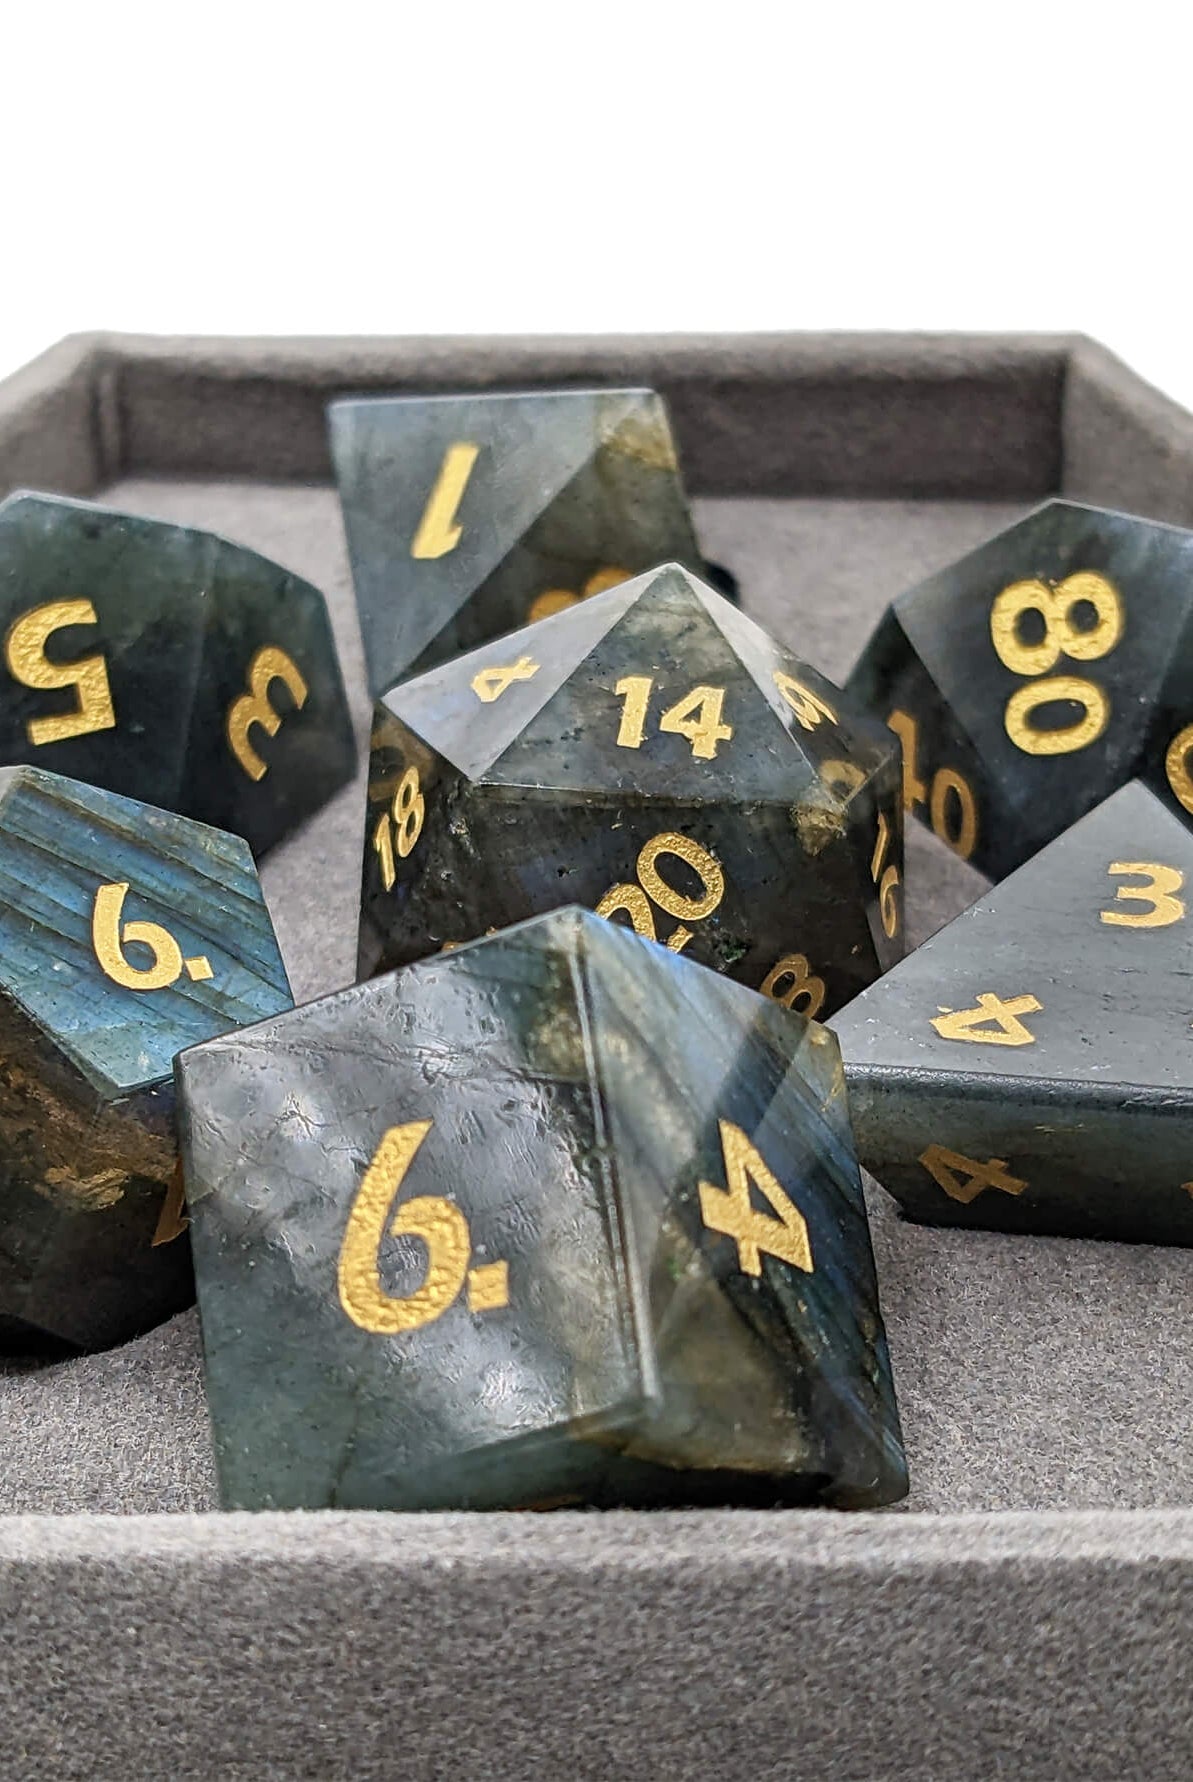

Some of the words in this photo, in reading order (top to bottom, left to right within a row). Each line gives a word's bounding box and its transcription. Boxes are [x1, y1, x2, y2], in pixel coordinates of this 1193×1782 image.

[412, 442, 480, 560] 1
[6, 600, 115, 745] 5
[228, 646, 309, 781] 3
[470, 656, 541, 702] 4
[614, 676, 733, 760] 14
[990, 571, 1126, 756] 80
[374, 766, 425, 892] 18
[1100, 862, 1185, 930] 3
[929, 992, 1044, 1047] 4
[337, 1120, 509, 1334] 6.
[699, 1119, 814, 1277] 4
[918, 1144, 1030, 1203] 4
